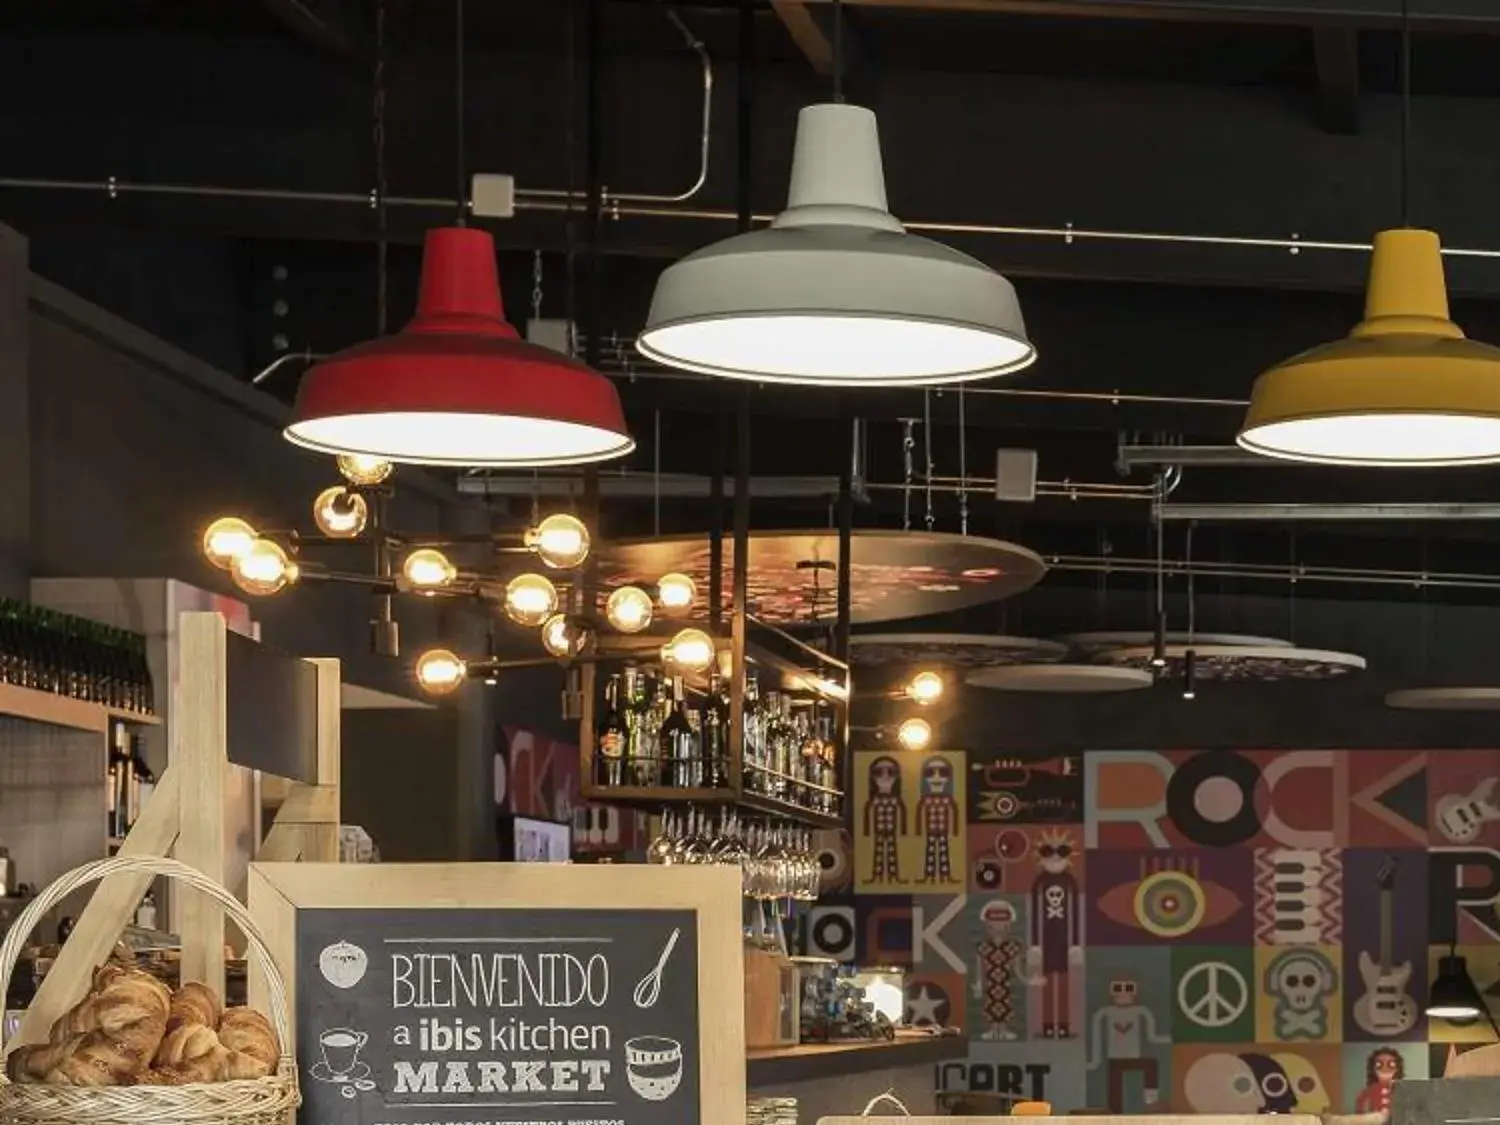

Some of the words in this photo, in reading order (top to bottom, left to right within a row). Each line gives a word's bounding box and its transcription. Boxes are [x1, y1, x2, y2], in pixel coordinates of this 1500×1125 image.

[391, 953, 609, 1008] BIENVENIDO
[393, 1025, 411, 1045] a
[419, 1018, 483, 1051] ibis
[490, 1017, 610, 1050] kitchen
[393, 1059, 611, 1093] MARKET
